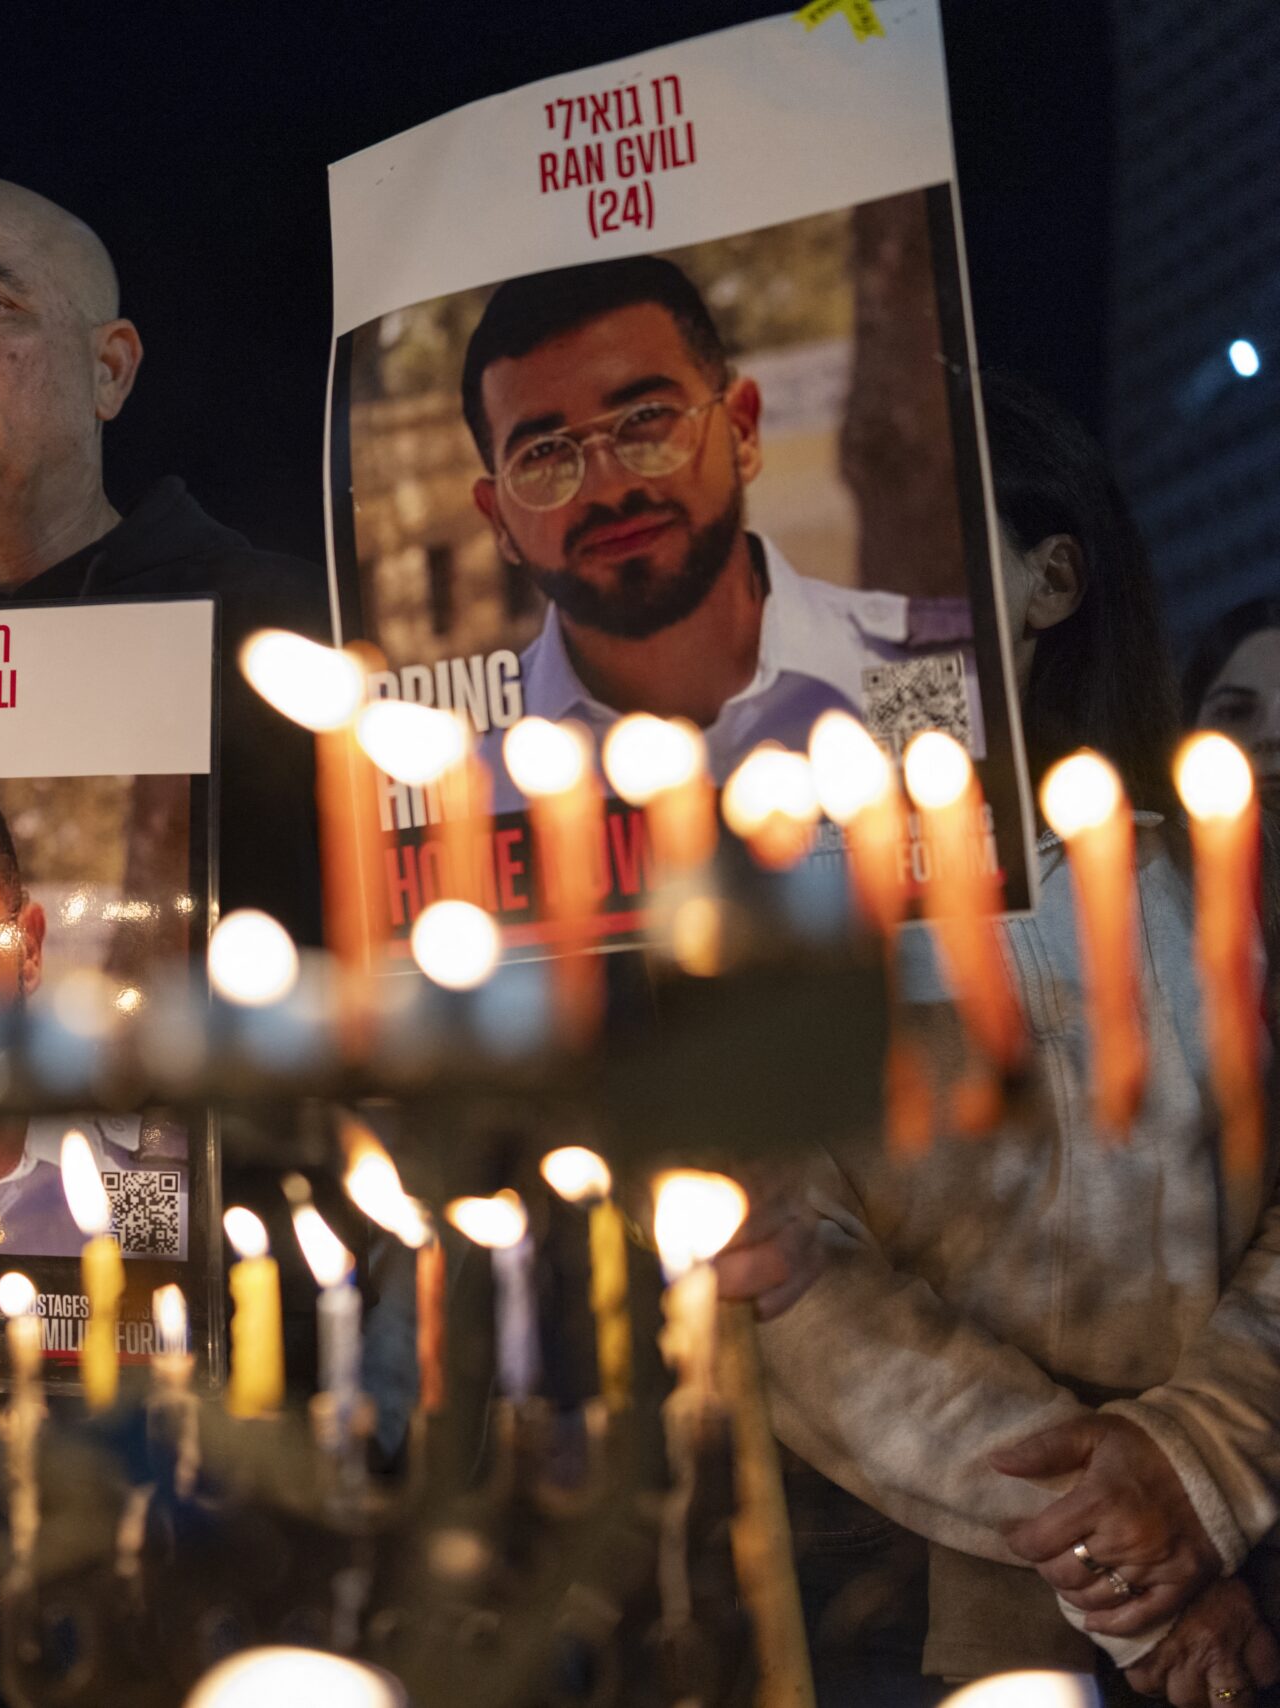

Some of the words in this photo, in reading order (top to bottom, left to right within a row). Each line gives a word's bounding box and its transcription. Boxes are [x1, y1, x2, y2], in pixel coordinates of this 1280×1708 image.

[544, 82, 643, 141] גואילי
[651, 74, 683, 125] רן
[539, 143, 606, 193] RAN
[615, 120, 697, 180] GVILI
[587, 180, 655, 239] (24)
[383, 827, 529, 926] HOE
[22, 1293, 90, 1319] OSTAGES
